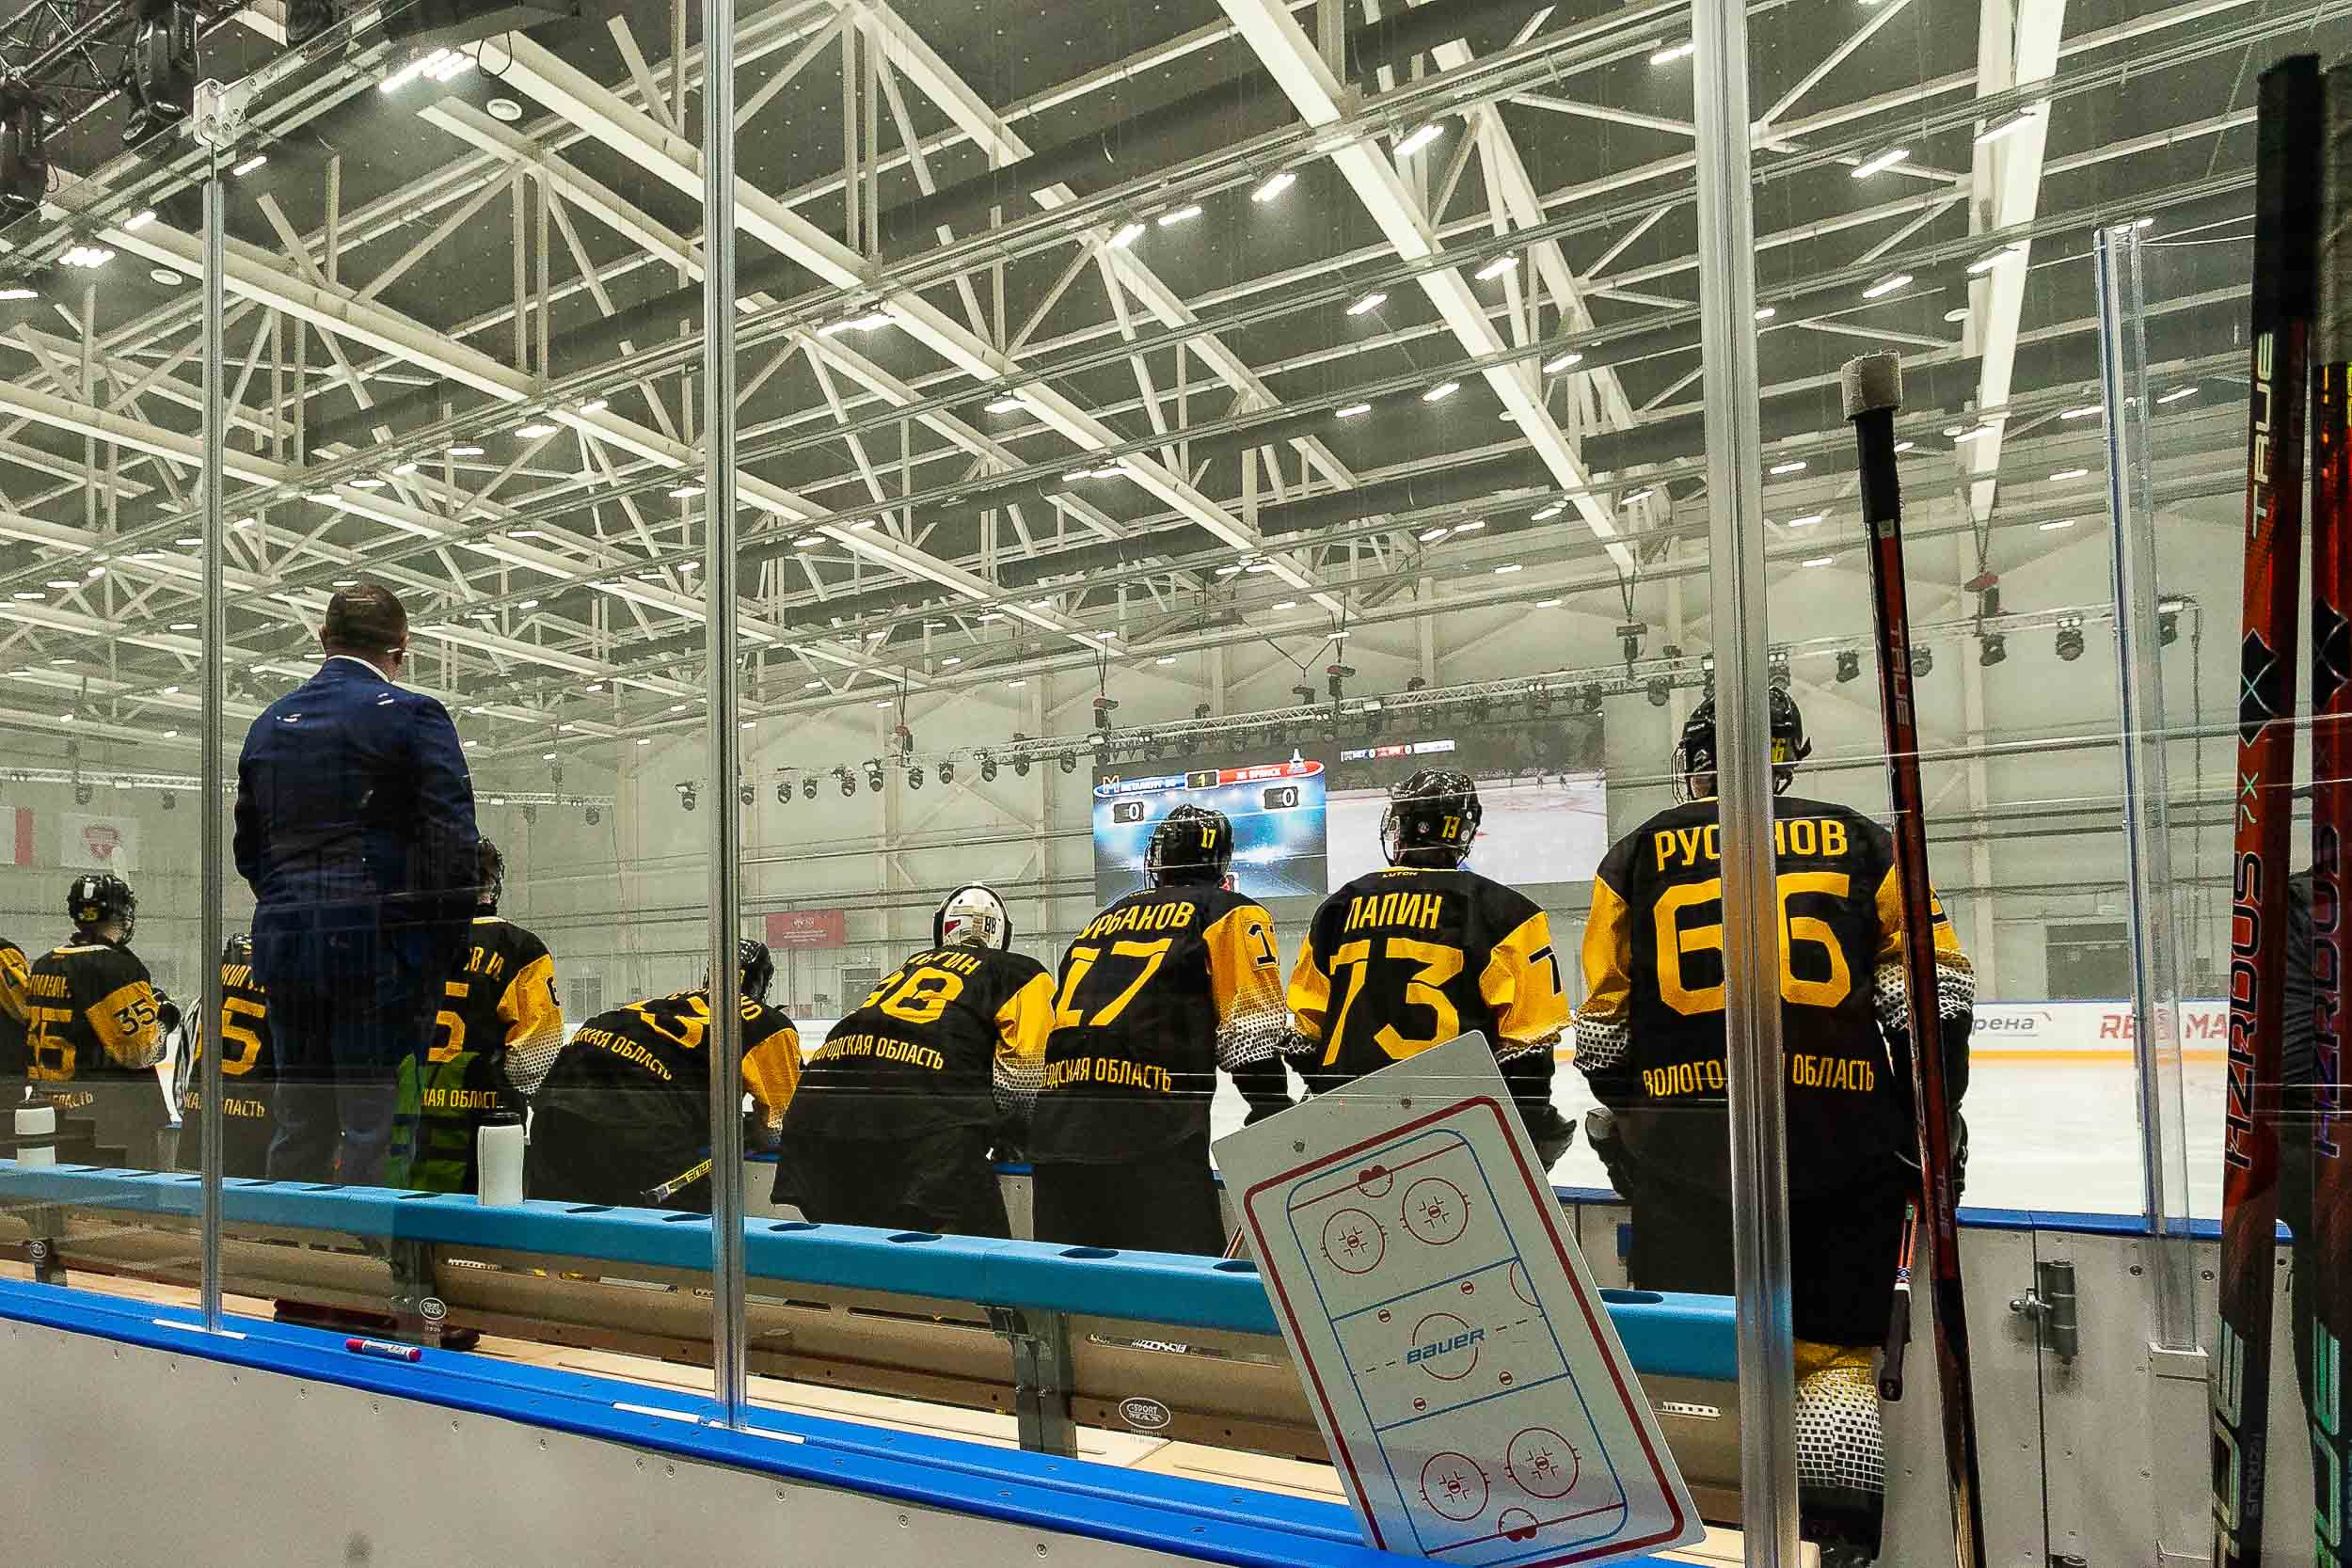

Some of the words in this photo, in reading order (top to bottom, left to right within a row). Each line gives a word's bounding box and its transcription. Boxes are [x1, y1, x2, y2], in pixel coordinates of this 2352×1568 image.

[2250, 332, 2273, 540] TRUE
[1199, 774, 1206, 786] 1
[1282, 788, 1295, 806] 0
[1128, 803, 1139, 820] 0
[1441, 816, 1460, 838] 73
[1201, 827, 1216, 849] 17
[1655, 820, 1849, 872] РУСОВ
[985, 916, 997, 934] 88
[1075, 901, 1196, 940] УРБАНОВ
[1343, 893, 1443, 934] ЛАПИН
[1248, 923, 1279, 968] 1
[1652, 871, 1851, 1017] 66
[1055, 937, 1174, 1028] 17
[112, 998, 158, 1036] 35
[1322, 937, 1464, 1067] 73
[2226, 850, 2264, 1171] HZRDUS
[1972, 1016, 2035, 1037] рена
[611, 1036, 673, 1082] ОБЛАСТЬ
[876, 1037, 944, 1069] ОБЛАСТЬ
[1095, 1057, 1172, 1093] ОБЛАСТЬ
[1793, 1053, 1875, 1092] ОБЛАСТЬ
[1406, 1328, 1485, 1365] BAUER
